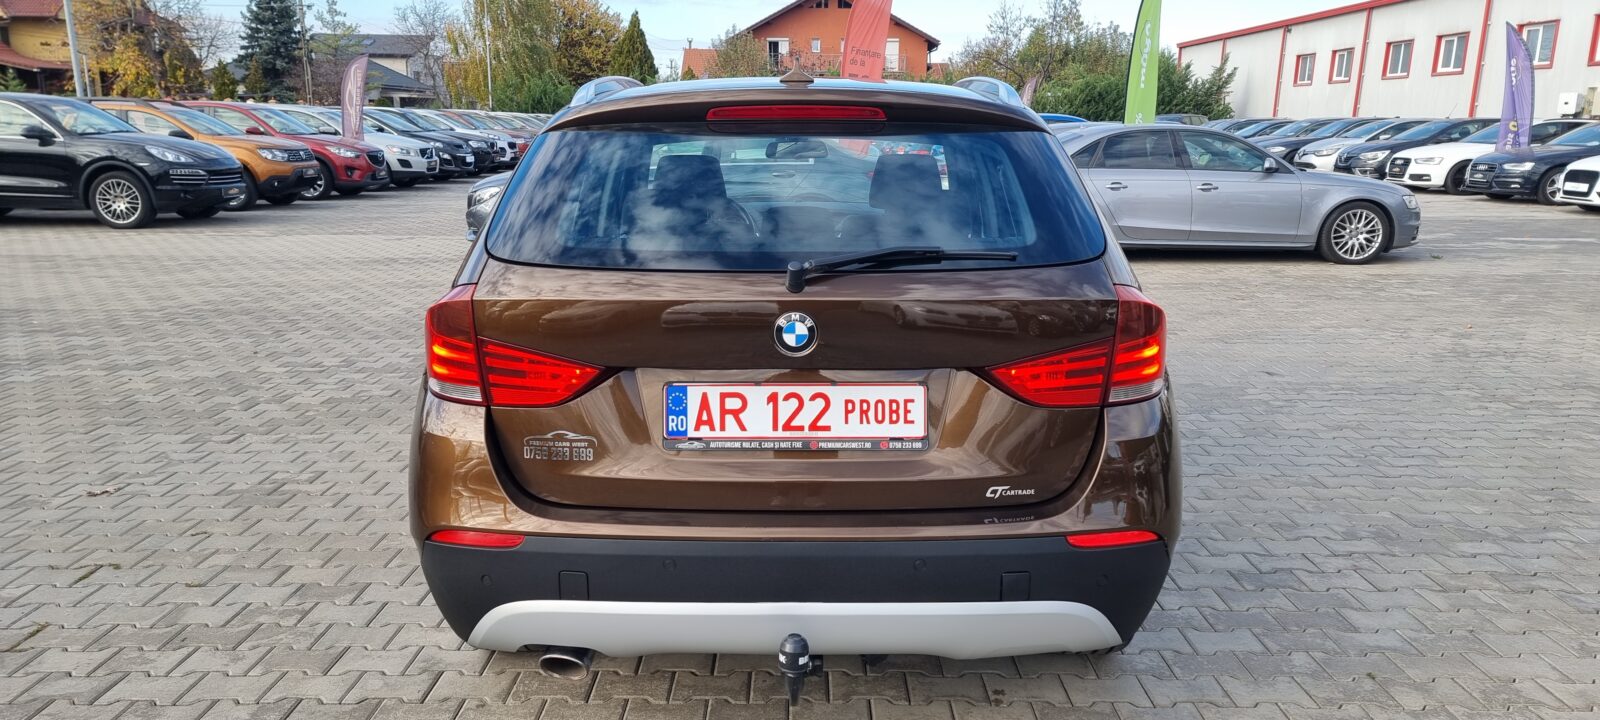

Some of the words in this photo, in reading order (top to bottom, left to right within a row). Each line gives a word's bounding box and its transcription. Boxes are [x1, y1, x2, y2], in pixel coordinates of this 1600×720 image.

[850, 57, 858, 66] de
[860, 58, 866, 66] la
[778, 314, 813, 327] BMW
[694, 392, 748, 432] AR
[767, 392, 831, 432] 122
[844, 399, 915, 424] PROBE
[668, 416, 686, 432] RO
